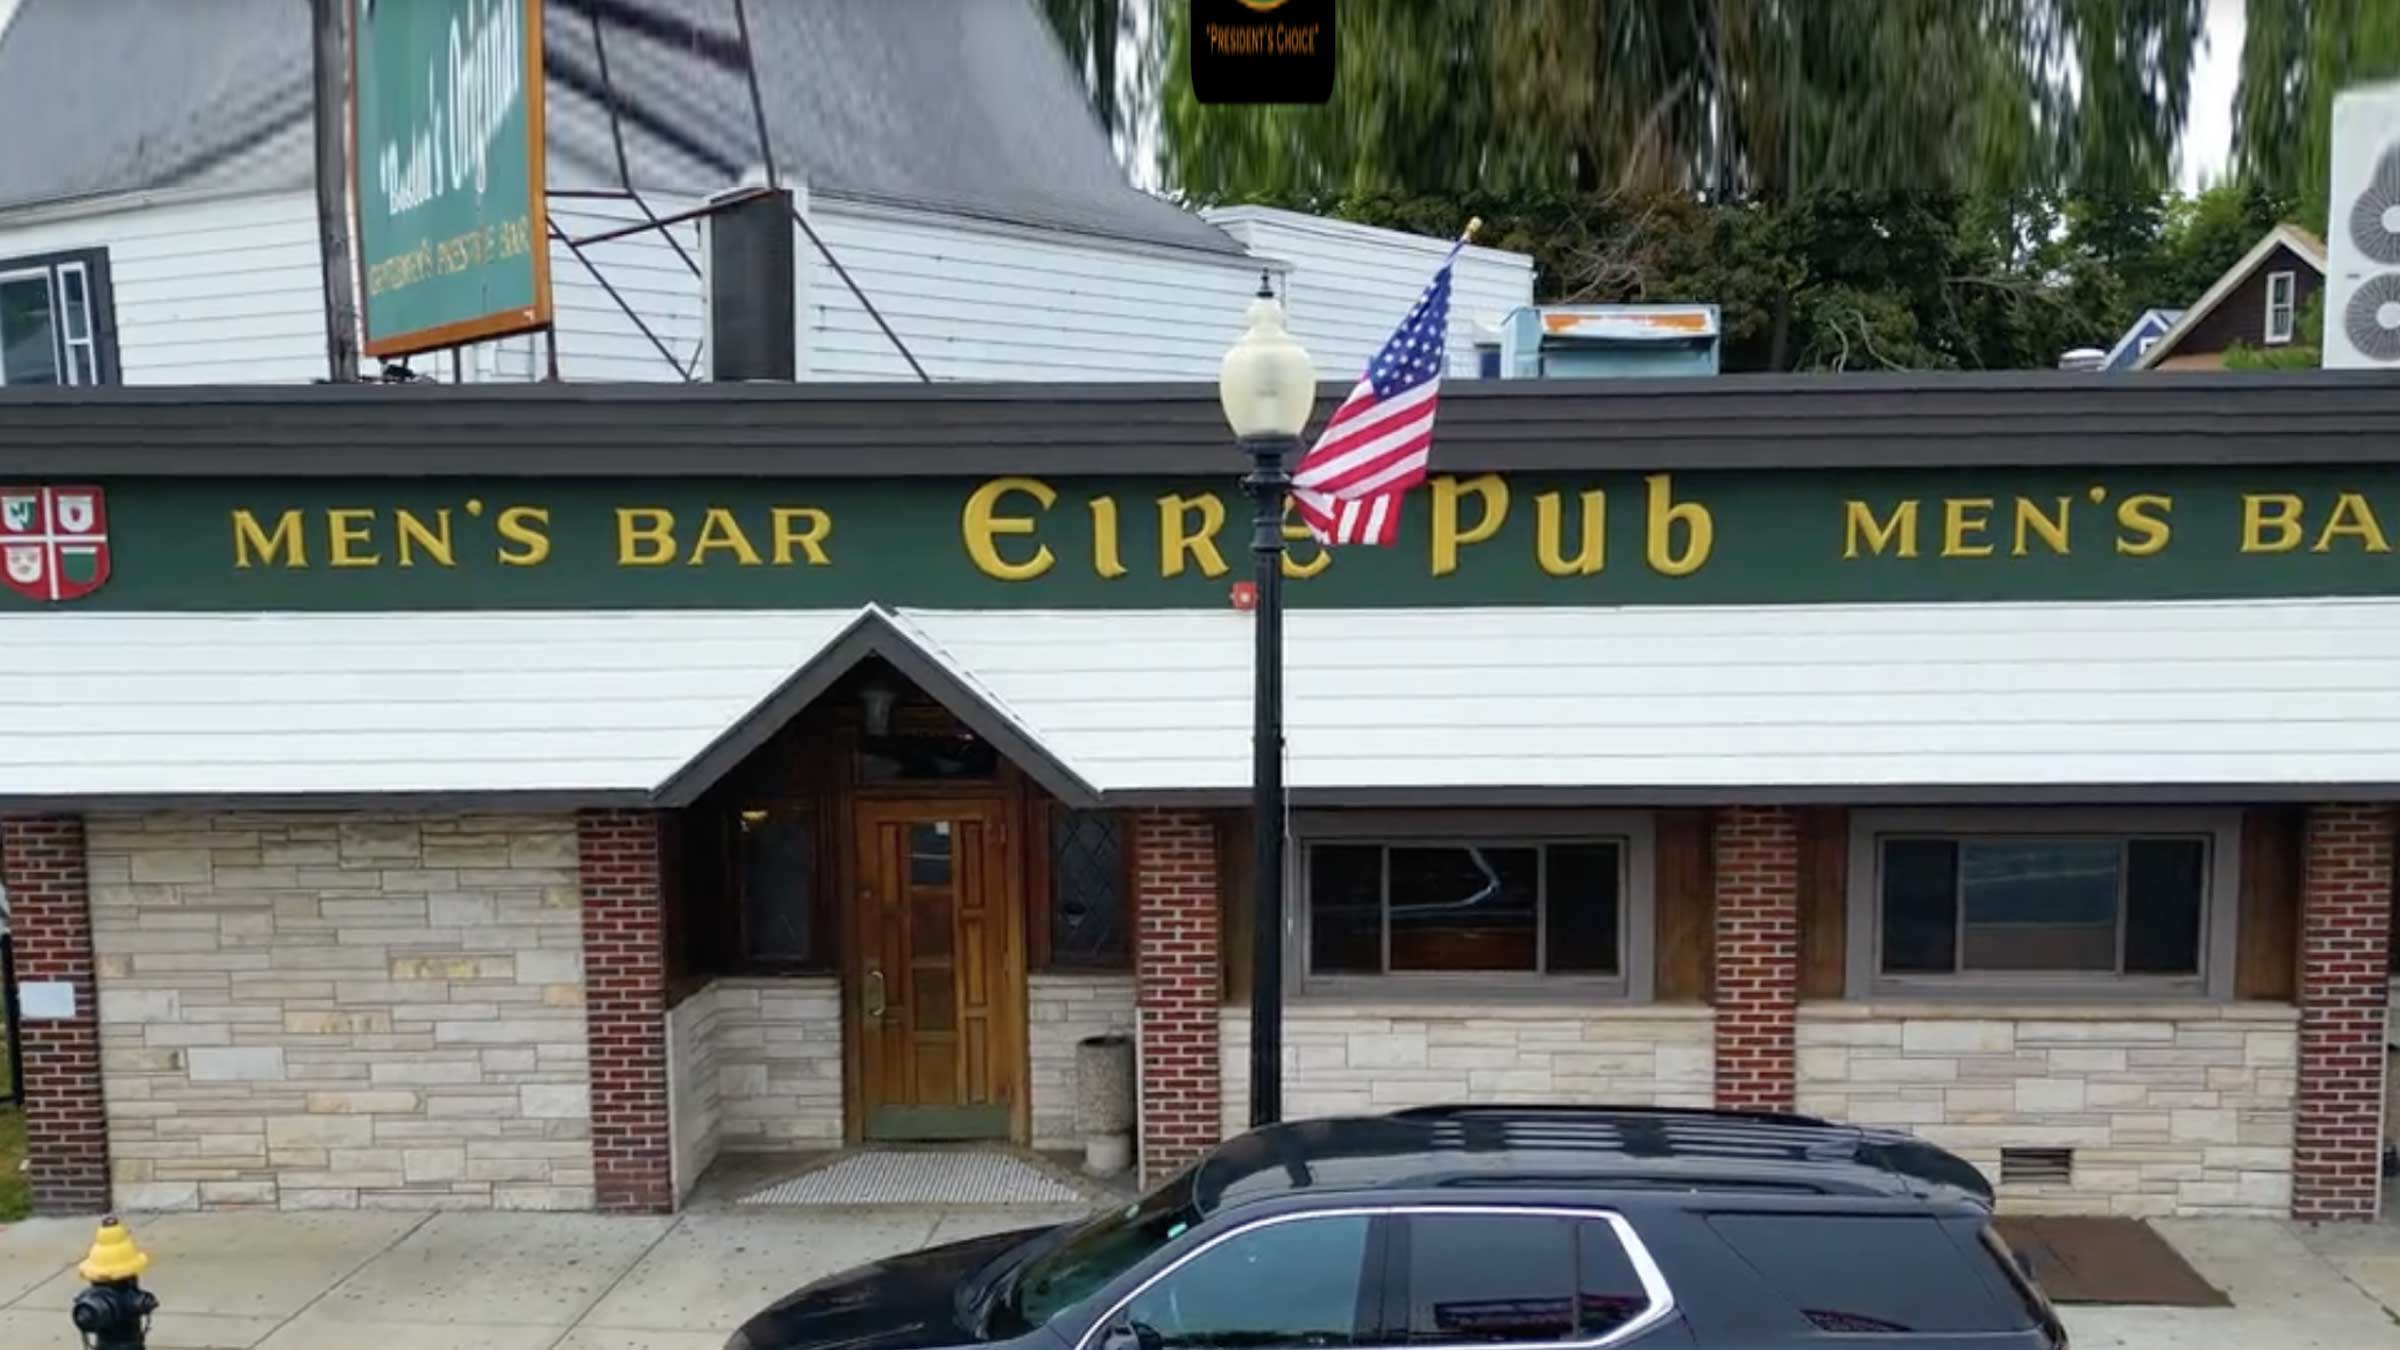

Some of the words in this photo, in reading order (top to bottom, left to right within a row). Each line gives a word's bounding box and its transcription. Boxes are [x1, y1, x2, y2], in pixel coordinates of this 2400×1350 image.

[232, 498, 551, 567] MEN'S
[616, 507, 832, 567] BAR
[1842, 487, 2173, 558] MEN'S
[2241, 493, 2400, 554] BA
